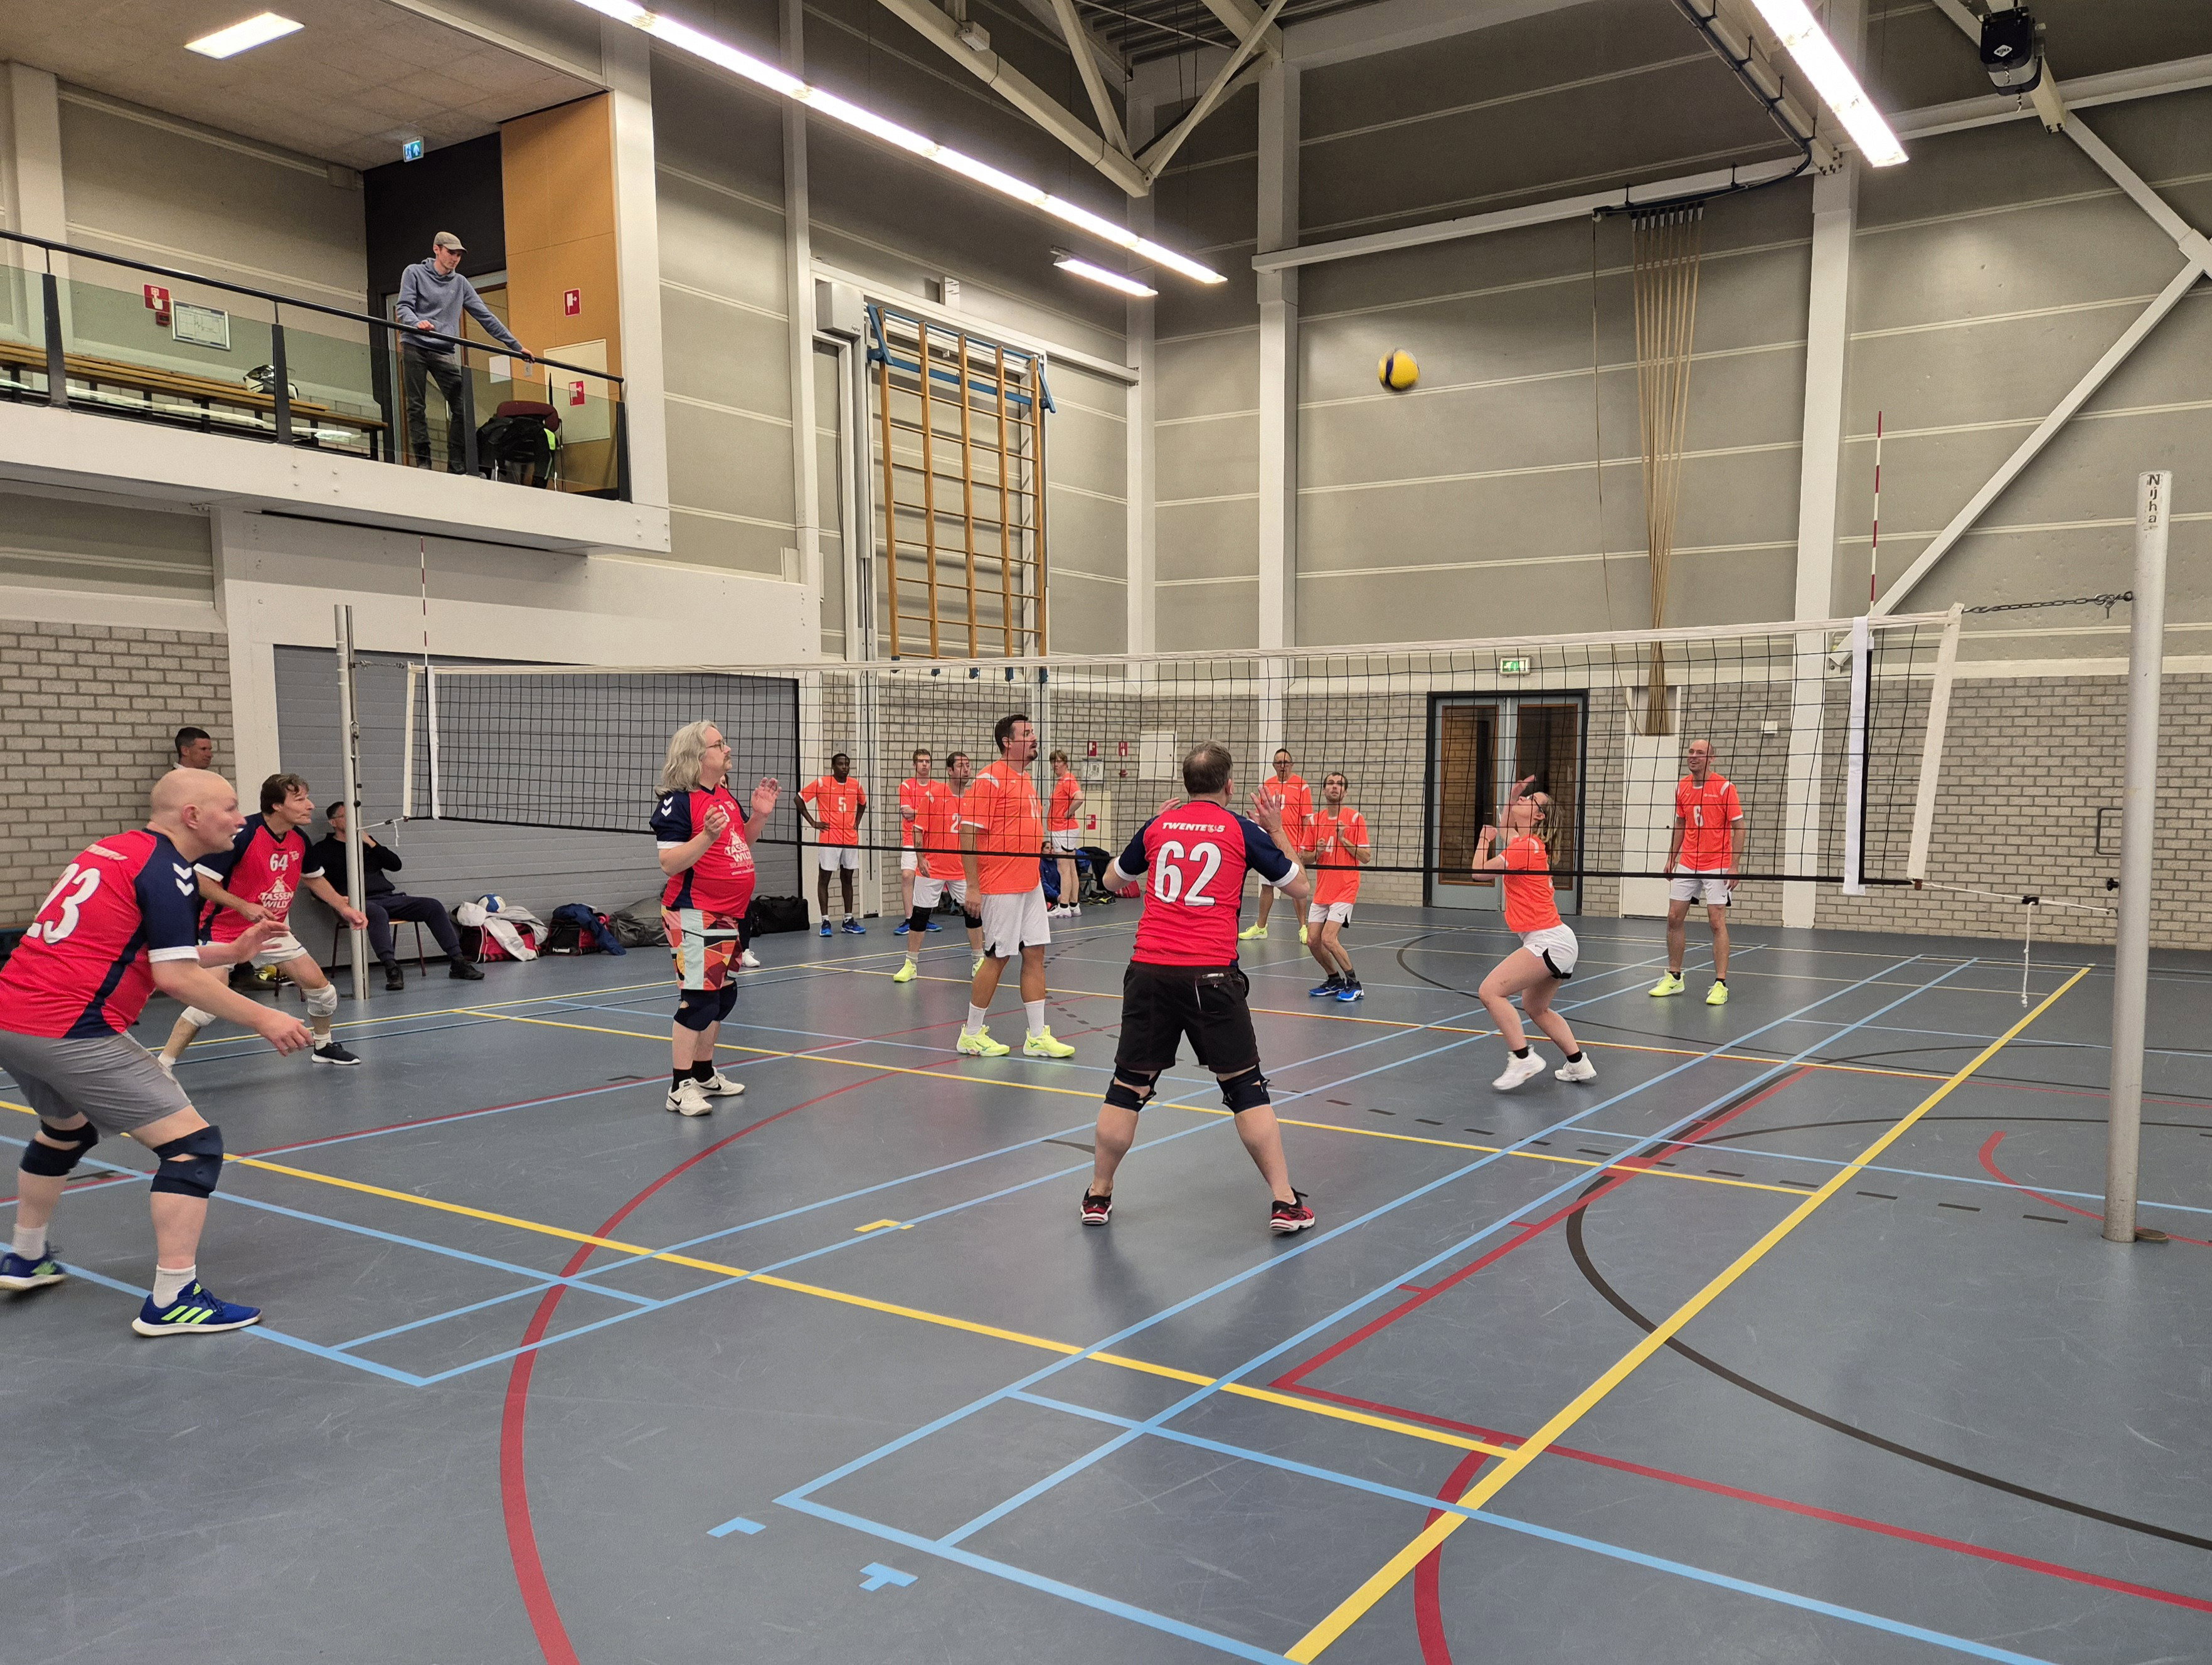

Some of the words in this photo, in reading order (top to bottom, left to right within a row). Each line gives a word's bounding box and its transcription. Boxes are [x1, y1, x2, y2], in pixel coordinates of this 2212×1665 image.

[2147, 474, 2161, 523] Nijha
[838, 796, 846, 812] 5
[950, 813, 961, 833] 2
[1693, 806, 1703, 827] 6
[1162, 822, 1208, 832] TWENTE
[1325, 836, 1334, 857] 4
[270, 853, 289, 871] 64
[1154, 840, 1221, 907] 62
[260, 891, 294, 901] TASSEN
